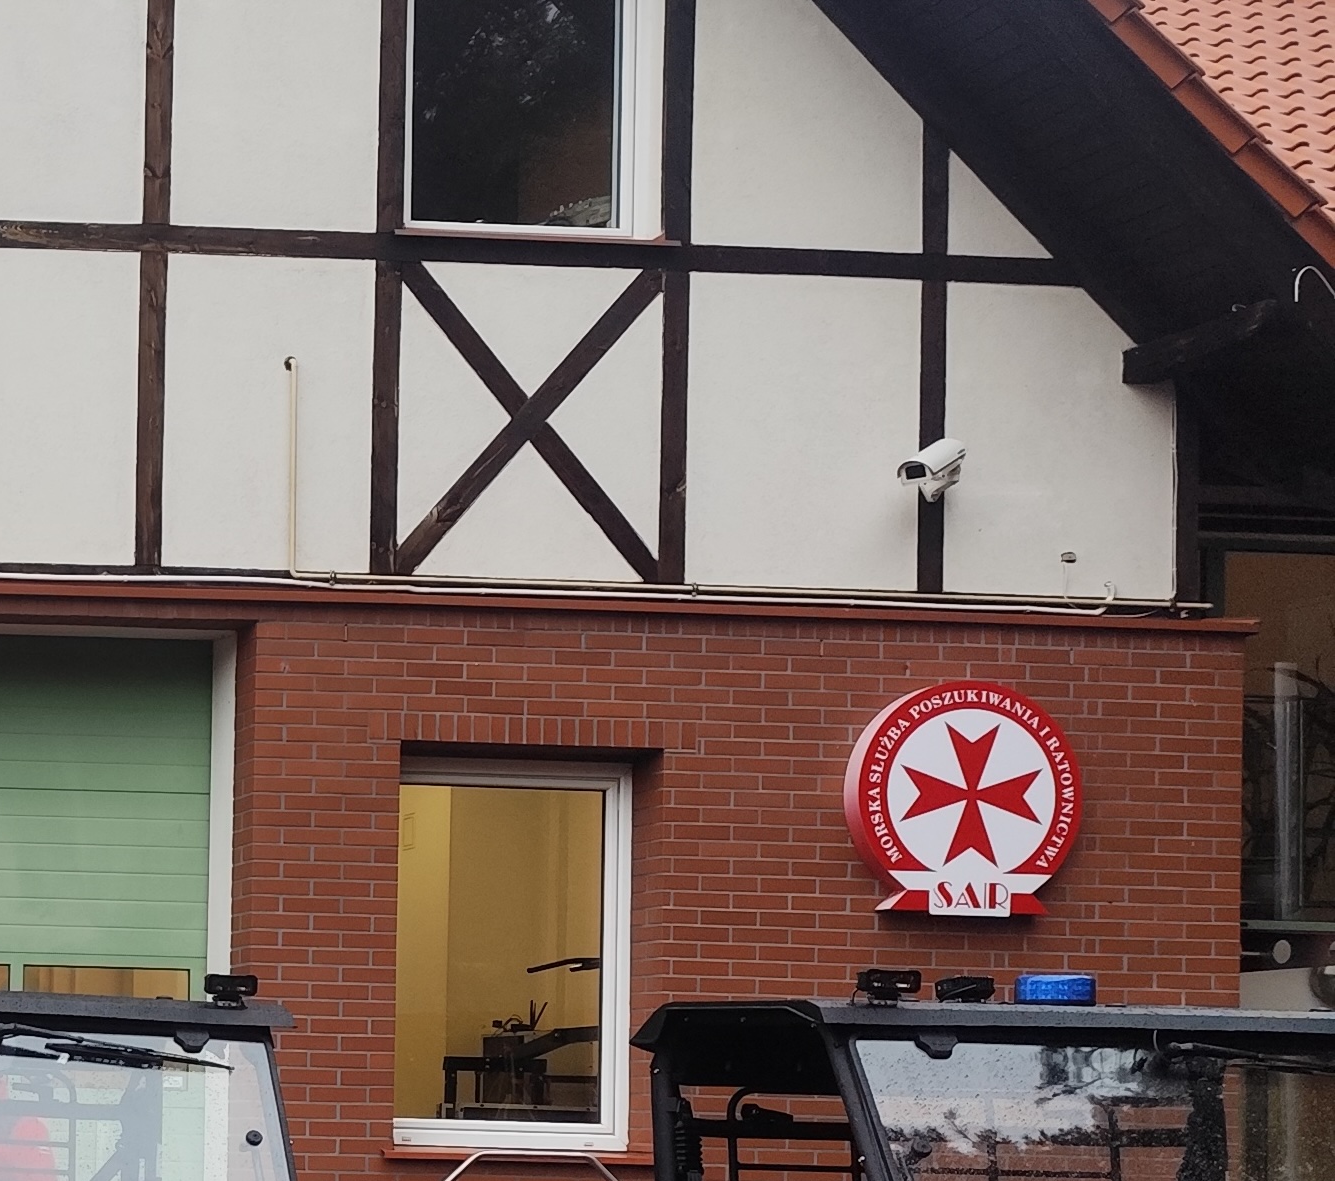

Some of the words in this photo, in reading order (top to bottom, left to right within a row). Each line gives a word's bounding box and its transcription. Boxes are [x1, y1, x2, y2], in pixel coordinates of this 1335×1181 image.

[908, 689, 1041, 729] POSZUKIWANIA
[1038, 725, 1052, 738] I
[868, 718, 911, 783] SŁUŻBA
[868, 786, 903, 864] MORSKA
[1035, 736, 1075, 868] RATOWNICTWA
[933, 881, 1009, 909] SAR
